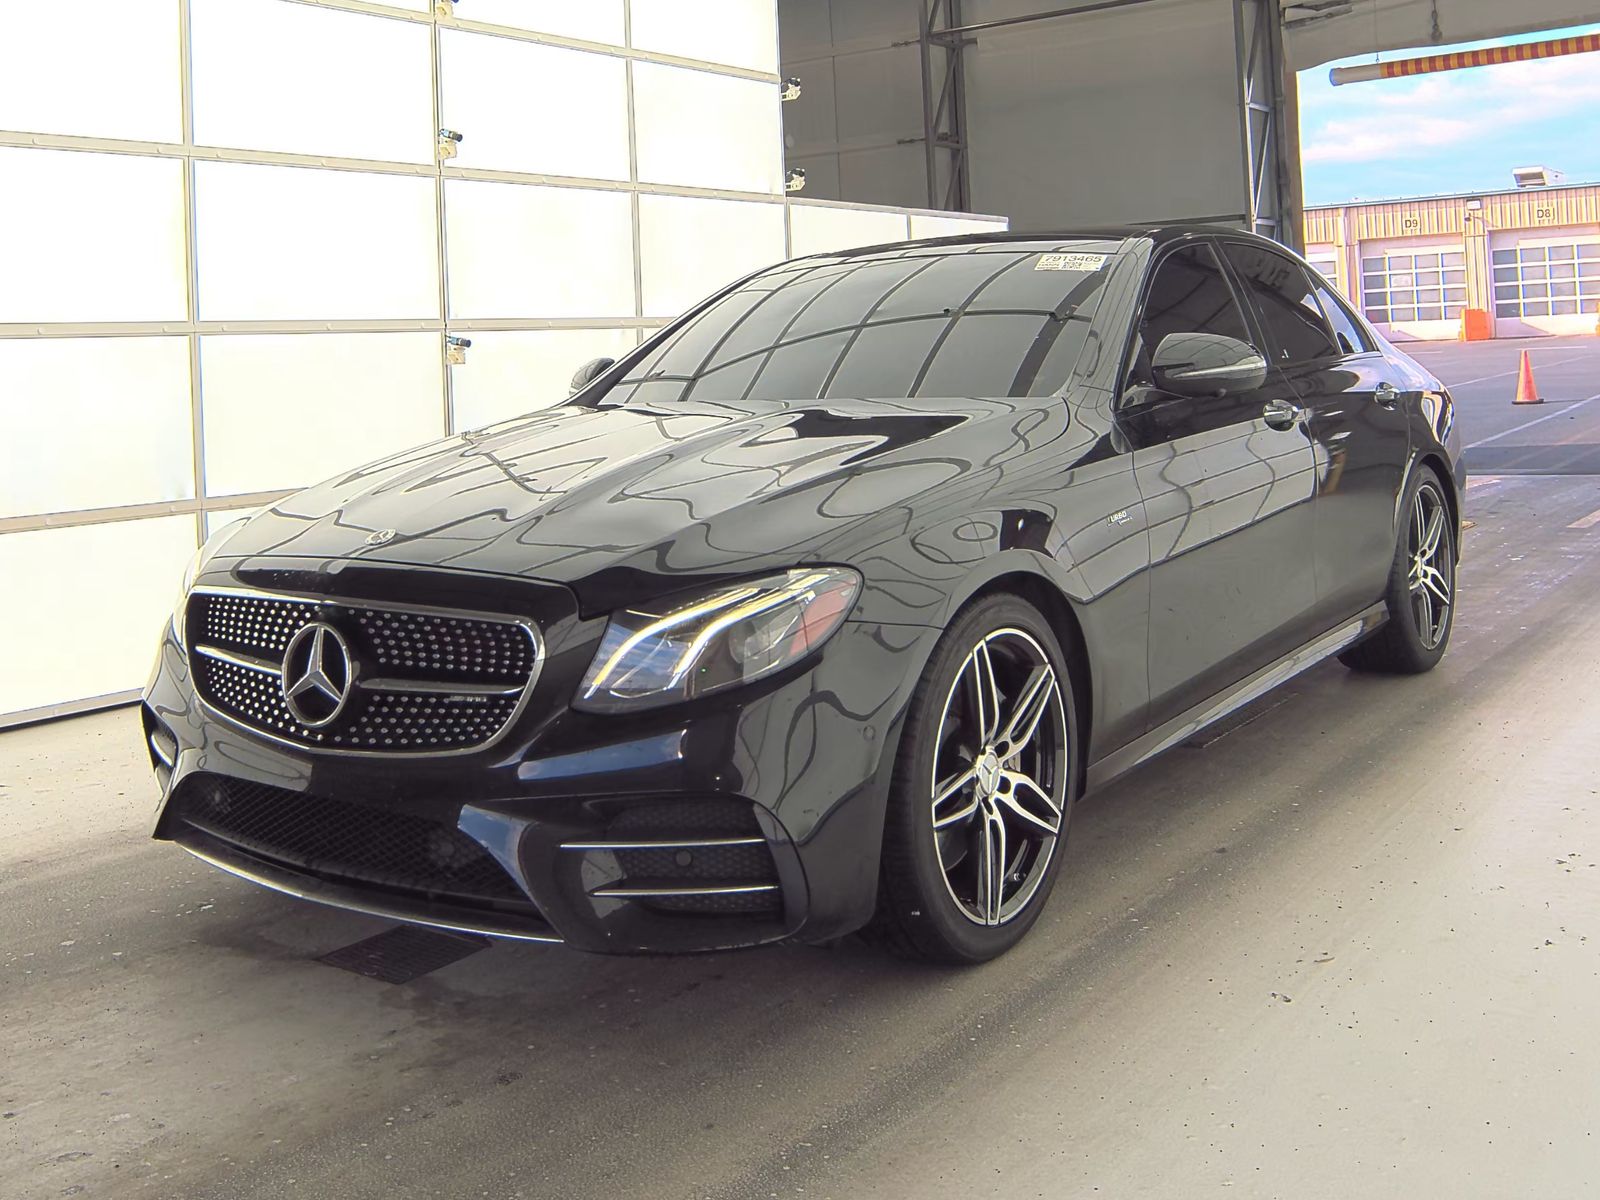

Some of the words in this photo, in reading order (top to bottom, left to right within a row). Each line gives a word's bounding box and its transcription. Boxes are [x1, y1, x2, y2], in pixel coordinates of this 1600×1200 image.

[1537, 209, 1551, 219] D8
[1405, 219, 1418, 229] D9
[1045, 255, 1102, 263] 7913465
